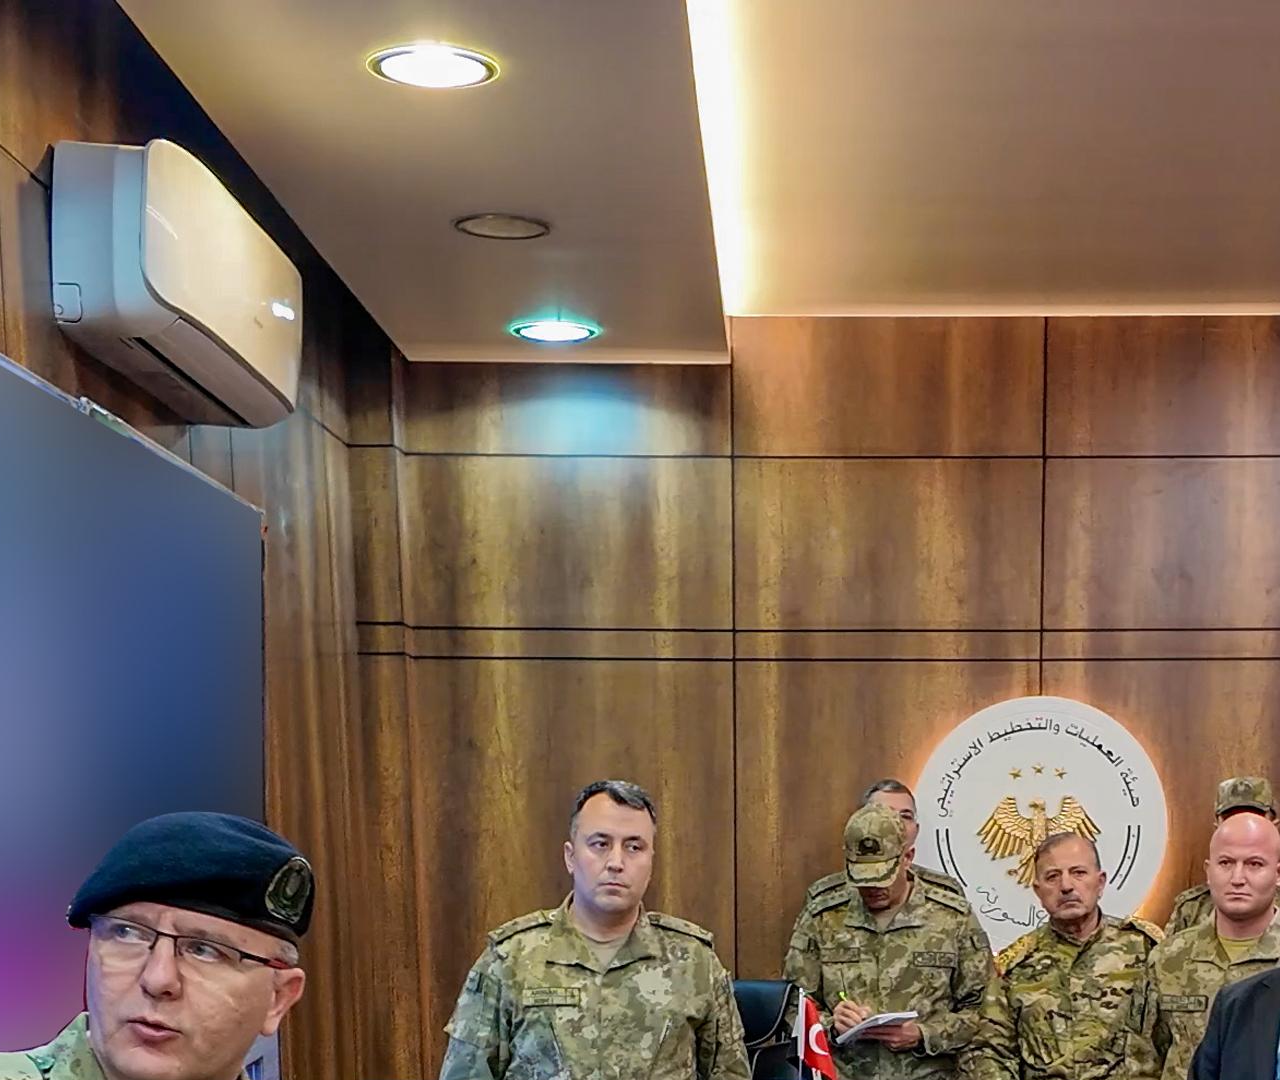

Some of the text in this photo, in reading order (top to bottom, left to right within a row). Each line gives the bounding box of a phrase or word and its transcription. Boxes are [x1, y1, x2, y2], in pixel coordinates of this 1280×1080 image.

[937, 717, 1139, 817] هيئة العمليات والتخطيط الاستراتيجي
